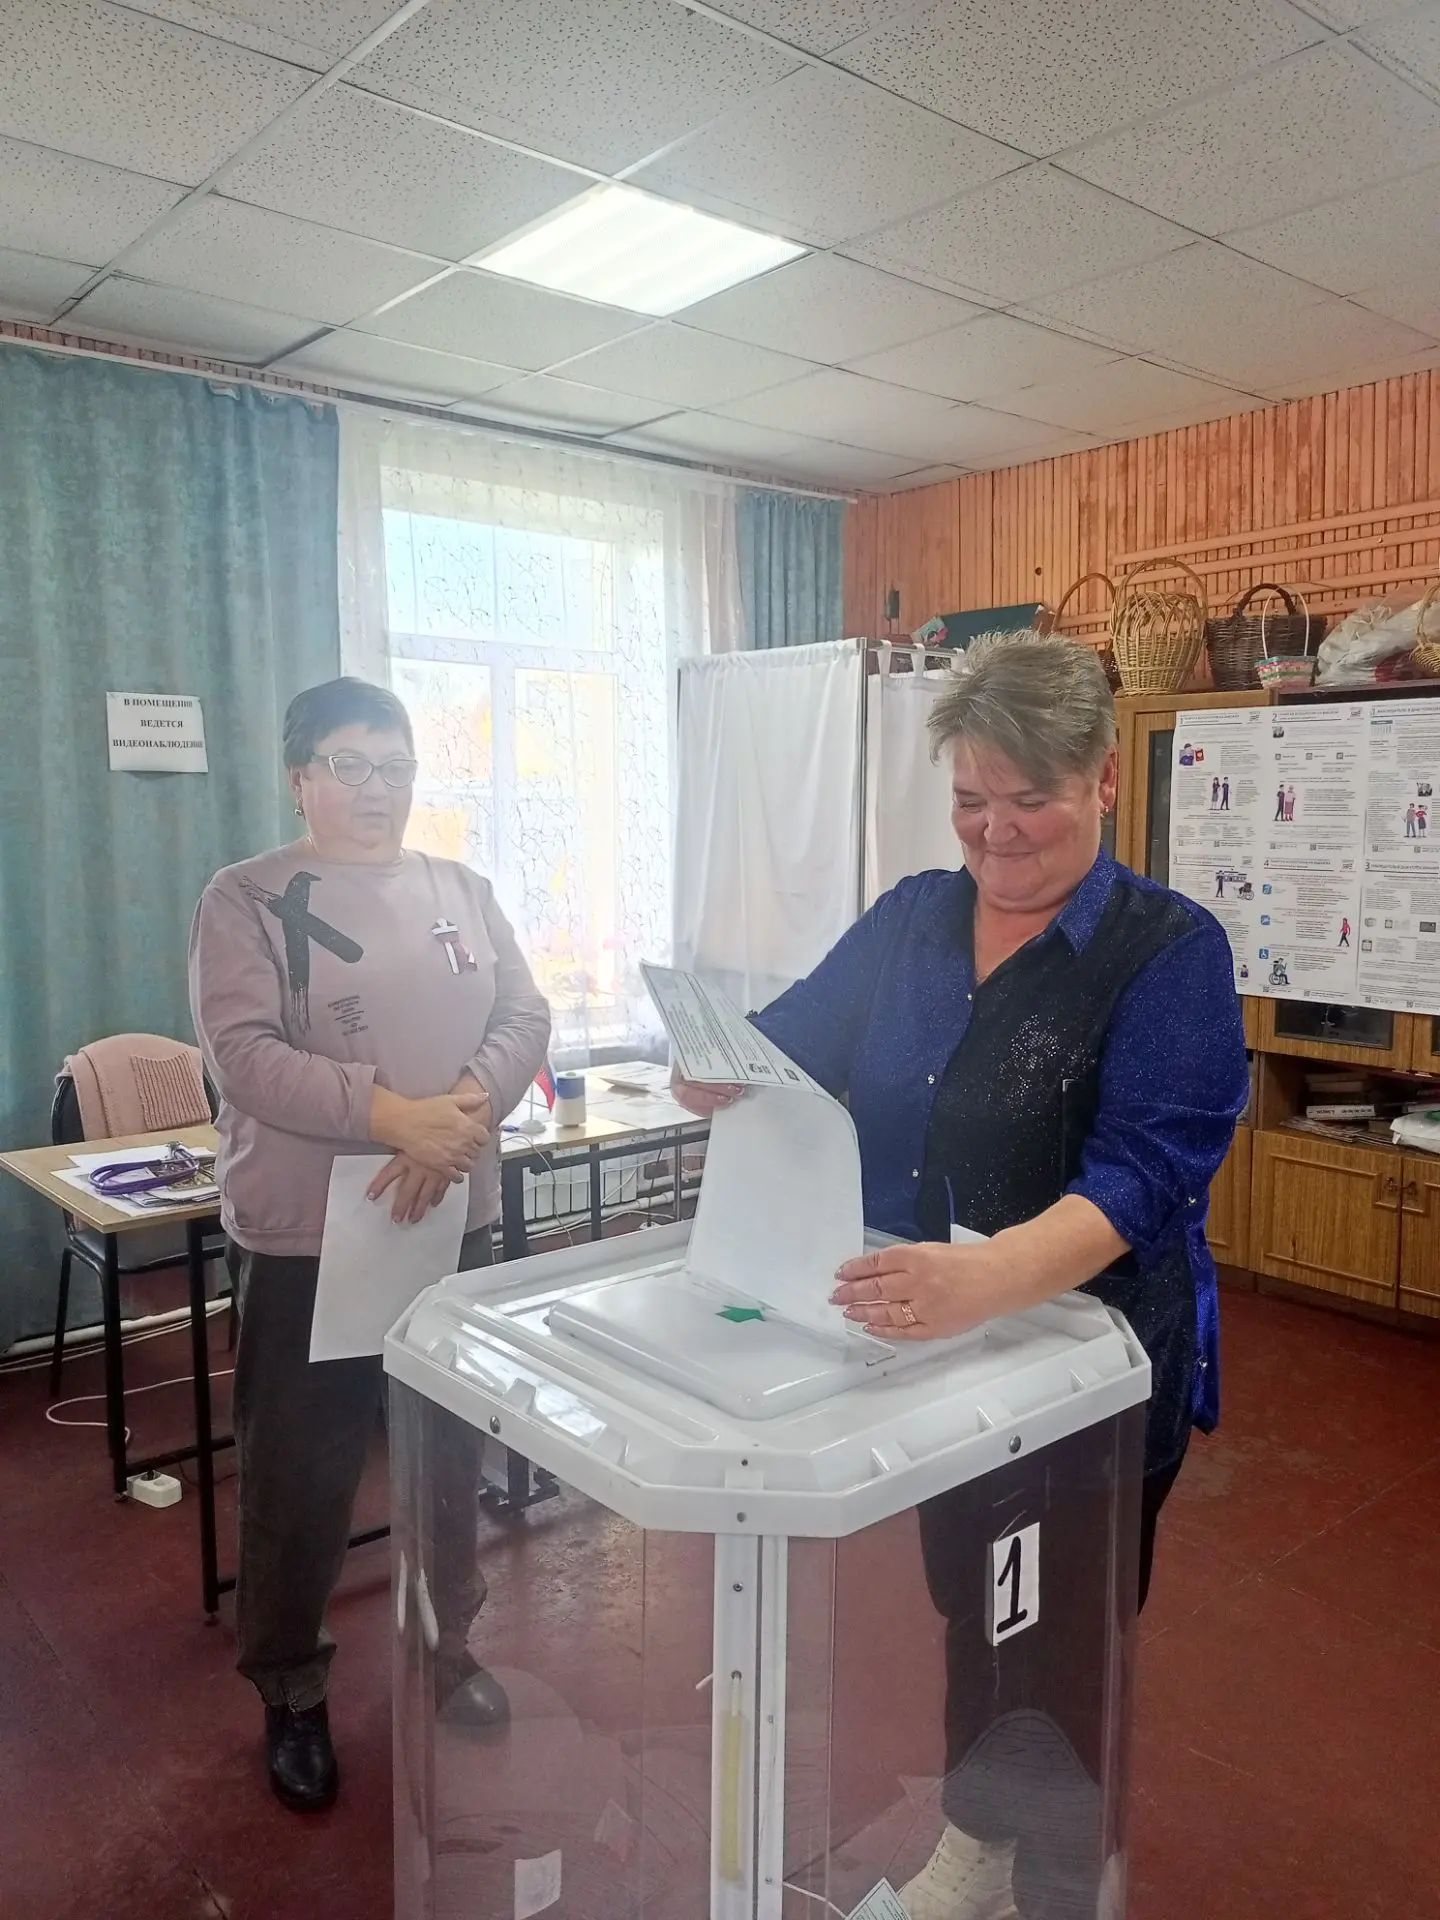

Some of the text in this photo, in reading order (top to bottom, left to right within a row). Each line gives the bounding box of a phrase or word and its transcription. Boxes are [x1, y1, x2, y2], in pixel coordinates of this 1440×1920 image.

[124, 698, 130, 706] В
[140, 719, 183, 728] ВЕДЕТСЯ
[997, 1536, 1028, 1634] 1
